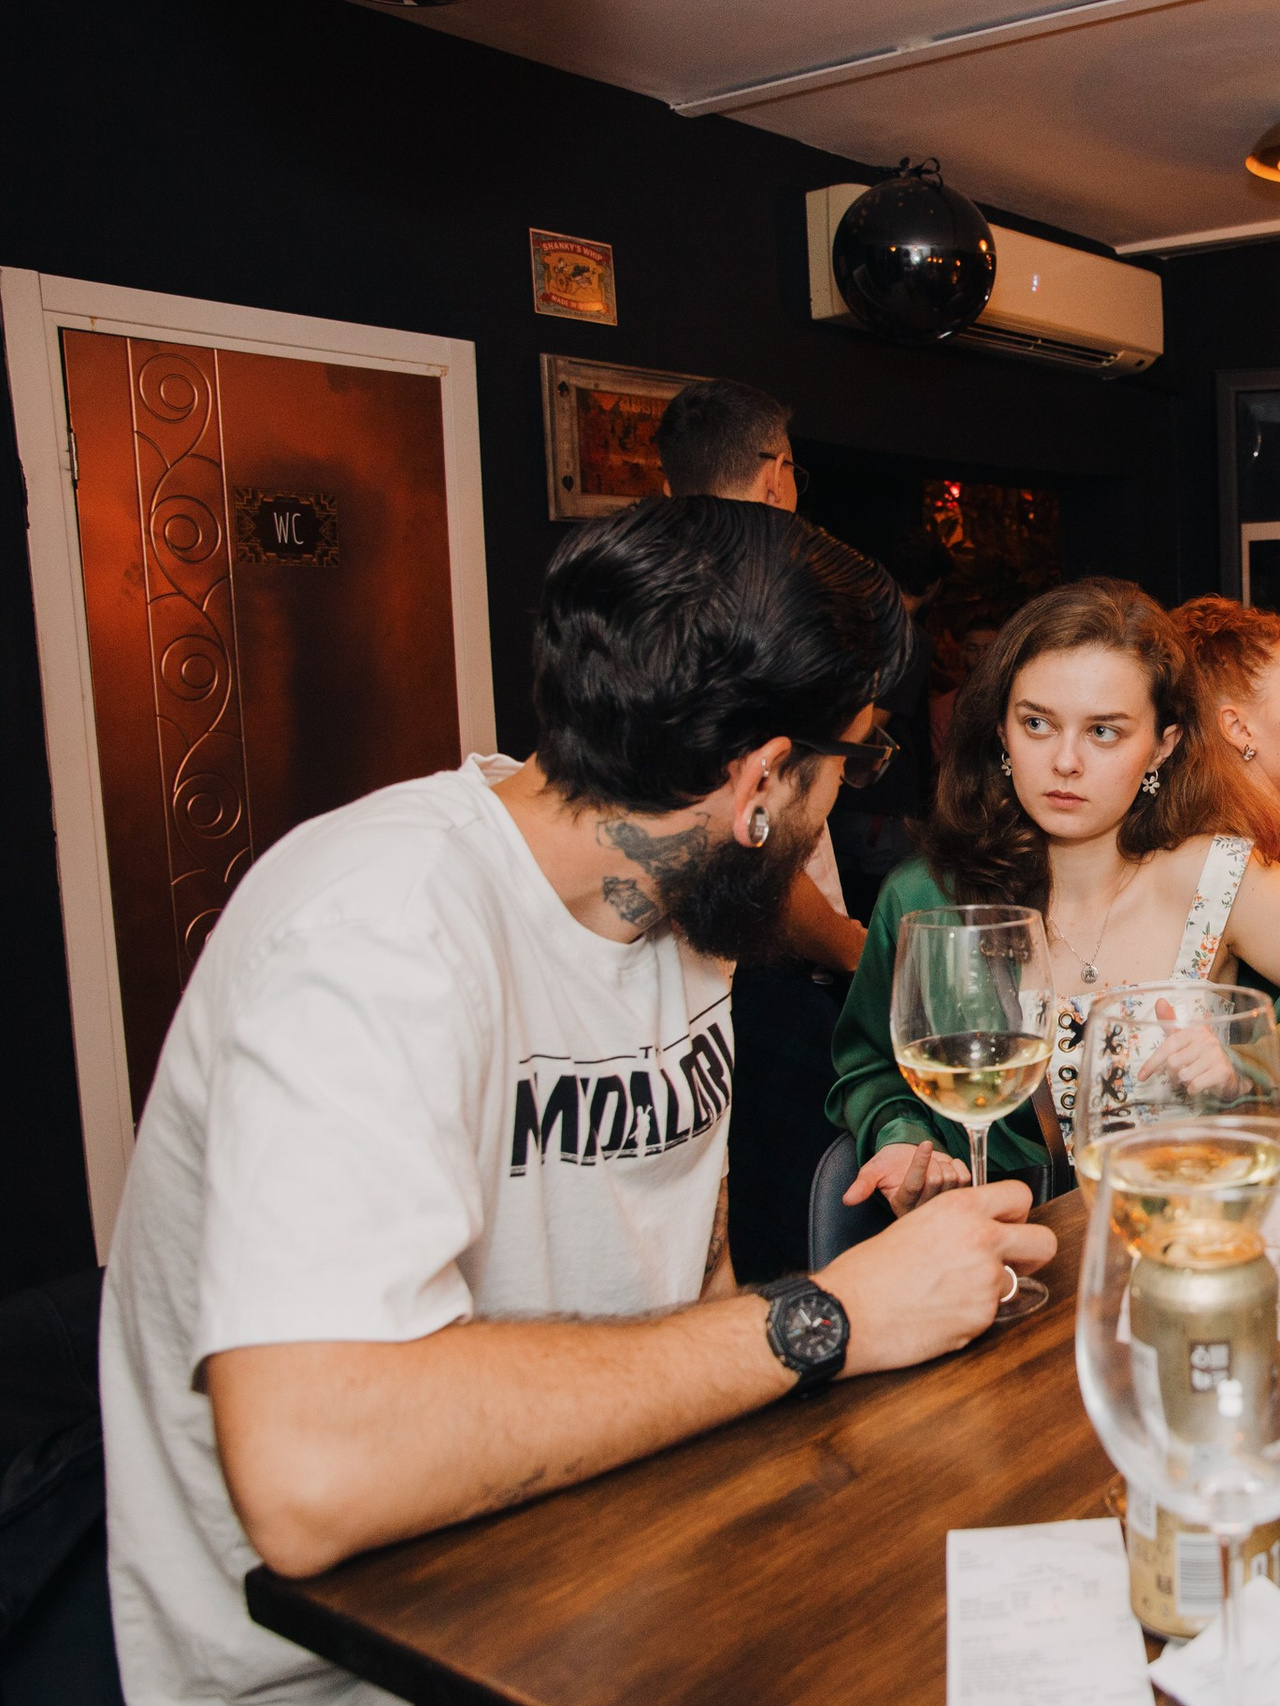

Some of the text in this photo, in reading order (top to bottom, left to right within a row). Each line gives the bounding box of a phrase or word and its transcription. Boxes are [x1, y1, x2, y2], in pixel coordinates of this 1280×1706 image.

[542, 241, 603, 261] SHANKY'S WHIP
[273, 511, 304, 545] WC
